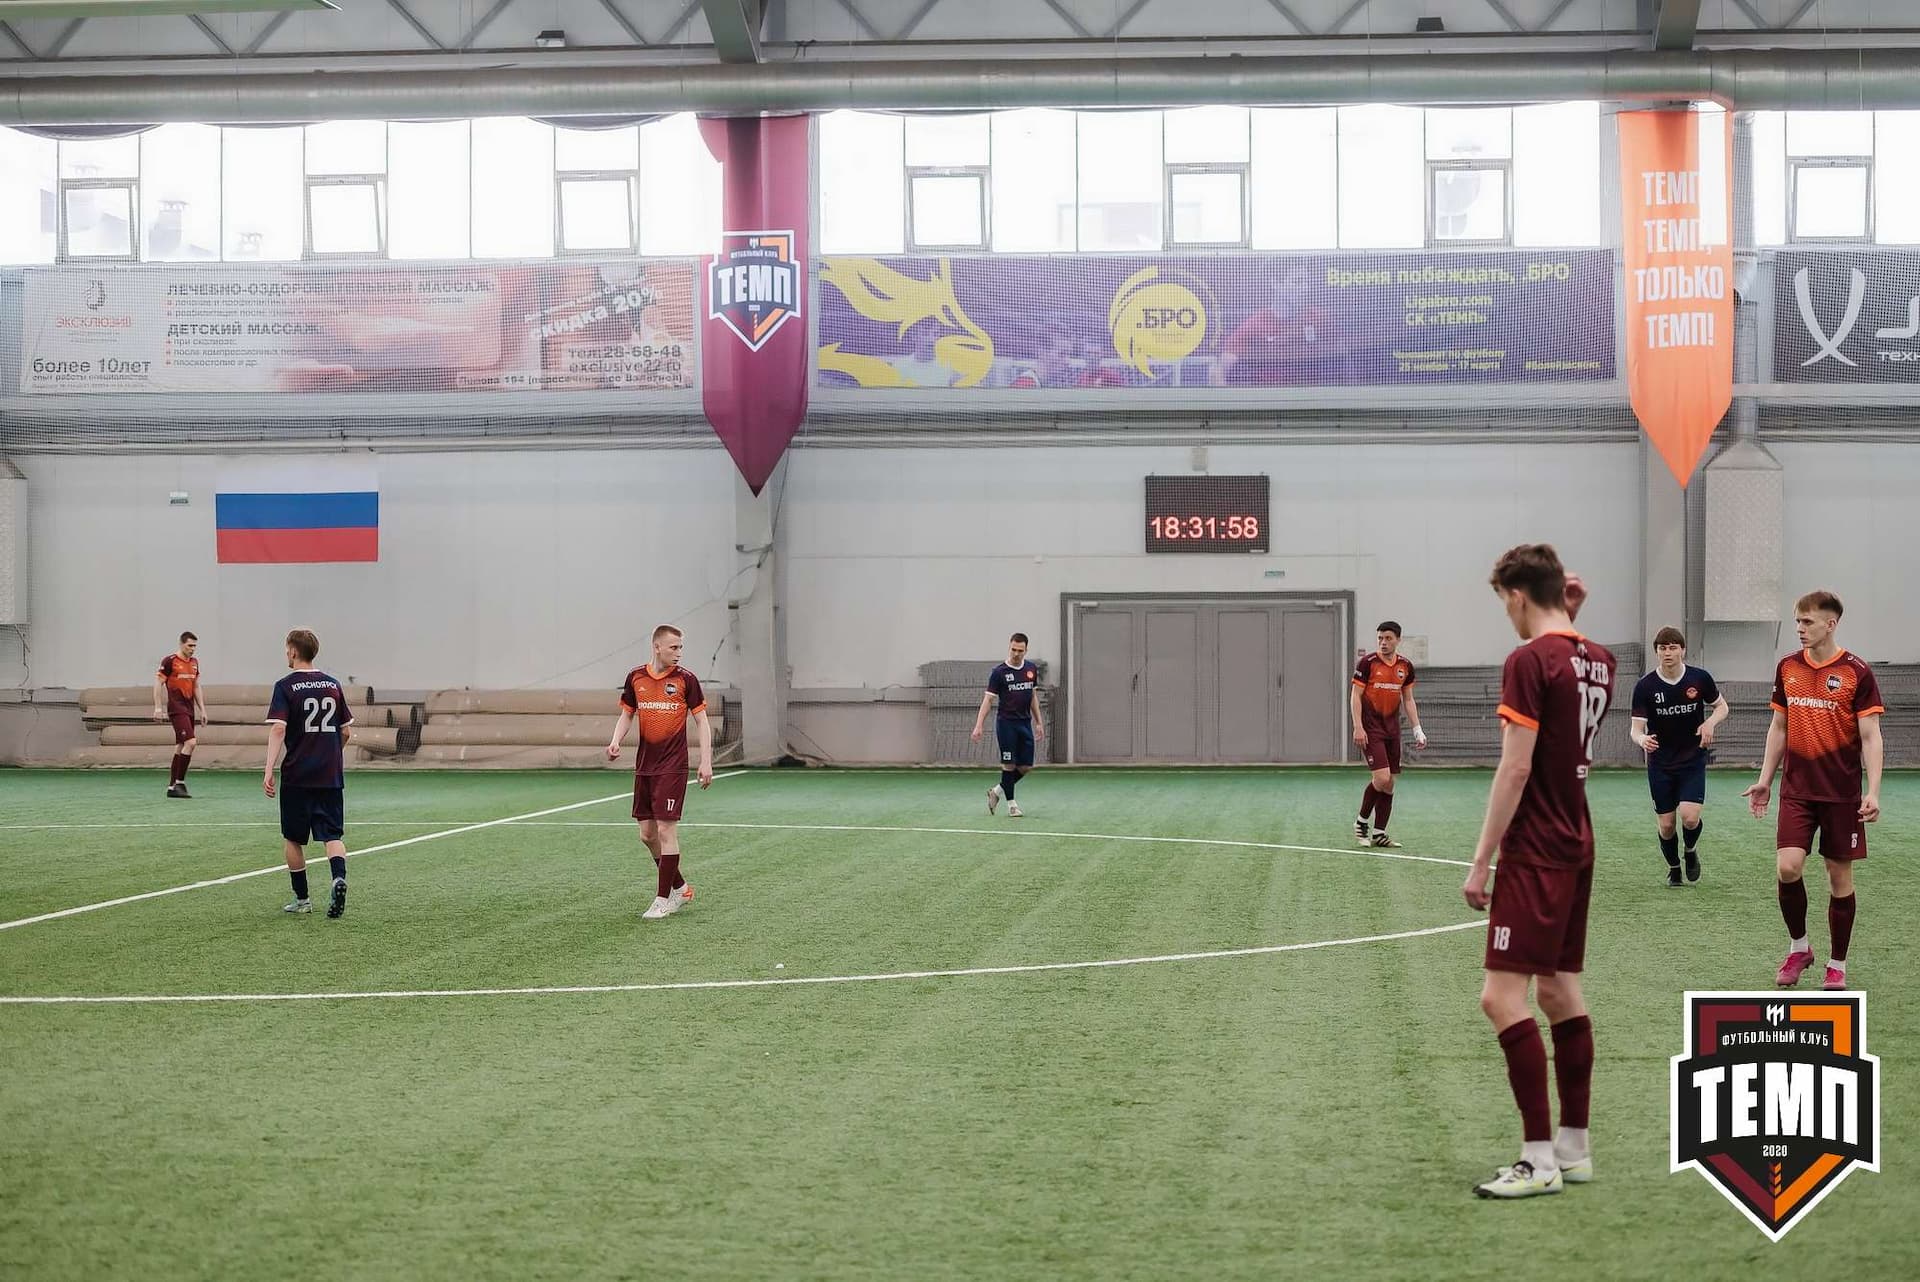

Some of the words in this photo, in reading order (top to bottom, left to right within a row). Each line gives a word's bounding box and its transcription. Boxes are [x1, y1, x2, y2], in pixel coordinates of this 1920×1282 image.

[717, 264, 792, 306] ТЕМП
[1327, 268, 1391, 287] Время
[1397, 265, 1515, 285] побеждать,
[1634, 265, 1725, 303] ТОЛЬКО
[612, 285, 665, 314] 20%
[167, 321, 242, 337] ДЕТСКИЙ
[1645, 312, 1715, 348] ТЕМП!
[33, 358, 91, 373] более
[1150, 516, 1259, 539] 18:31:58
[1654, 692, 1665, 704] 31
[1656, 702, 1698, 716] РАССВЕТ
[303, 696, 337, 733] 22
[667, 798, 675, 811] 17
[1493, 926, 1511, 951] 18
